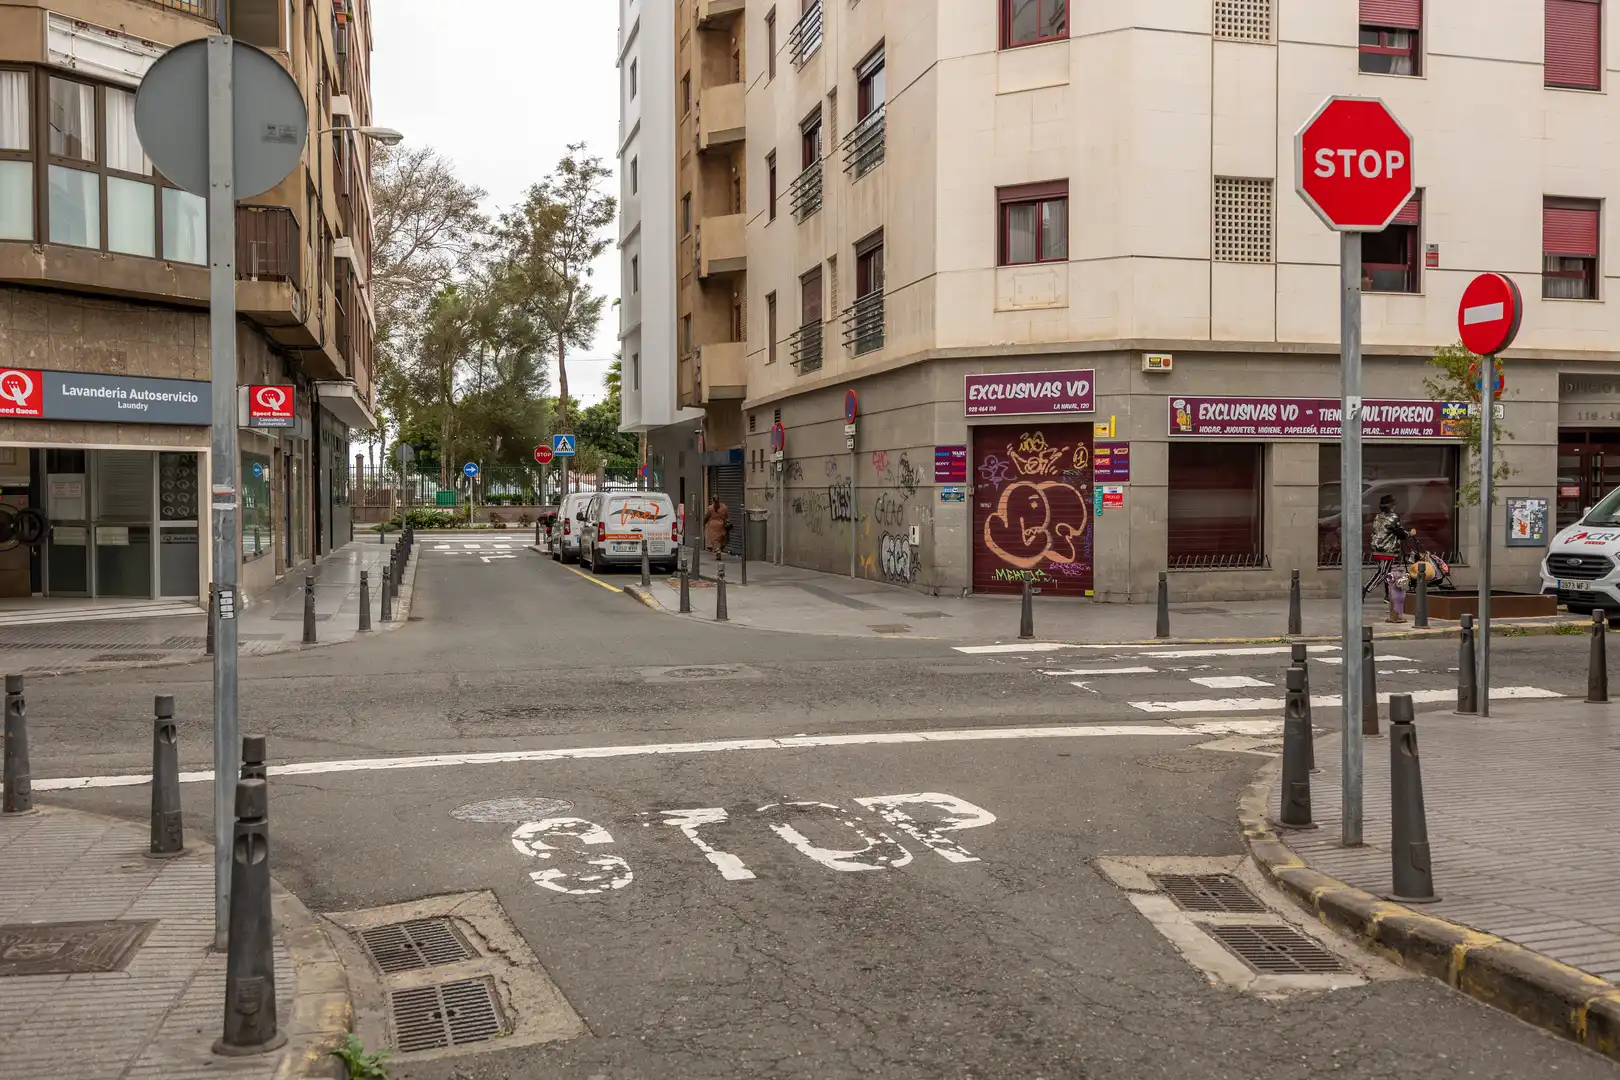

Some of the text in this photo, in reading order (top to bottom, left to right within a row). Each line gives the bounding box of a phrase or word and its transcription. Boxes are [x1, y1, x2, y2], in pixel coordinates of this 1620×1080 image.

[1313, 148, 1405, 178] STOP
[62, 384, 199, 403] Lavandería Autoservicio
[969, 380, 1090, 400] EXCLUSIVAS VD
[117, 401, 149, 411] Laundry
[1199, 403, 1277, 421] EXCLUSIVAS
[1280, 404, 1299, 421] VD
[1319, 407, 1342, 422] TIEN
[1199, 425, 1222, 434] HOGAR,
[1224, 425, 1256, 435] JUGUETES,
[1284, 424, 1318, 435] PAPELERÍA,
[1320, 426, 1342, 435] ELECTR
[1400, 428, 1421, 436] NAVAL,
[512, 792, 997, 895] STOP
